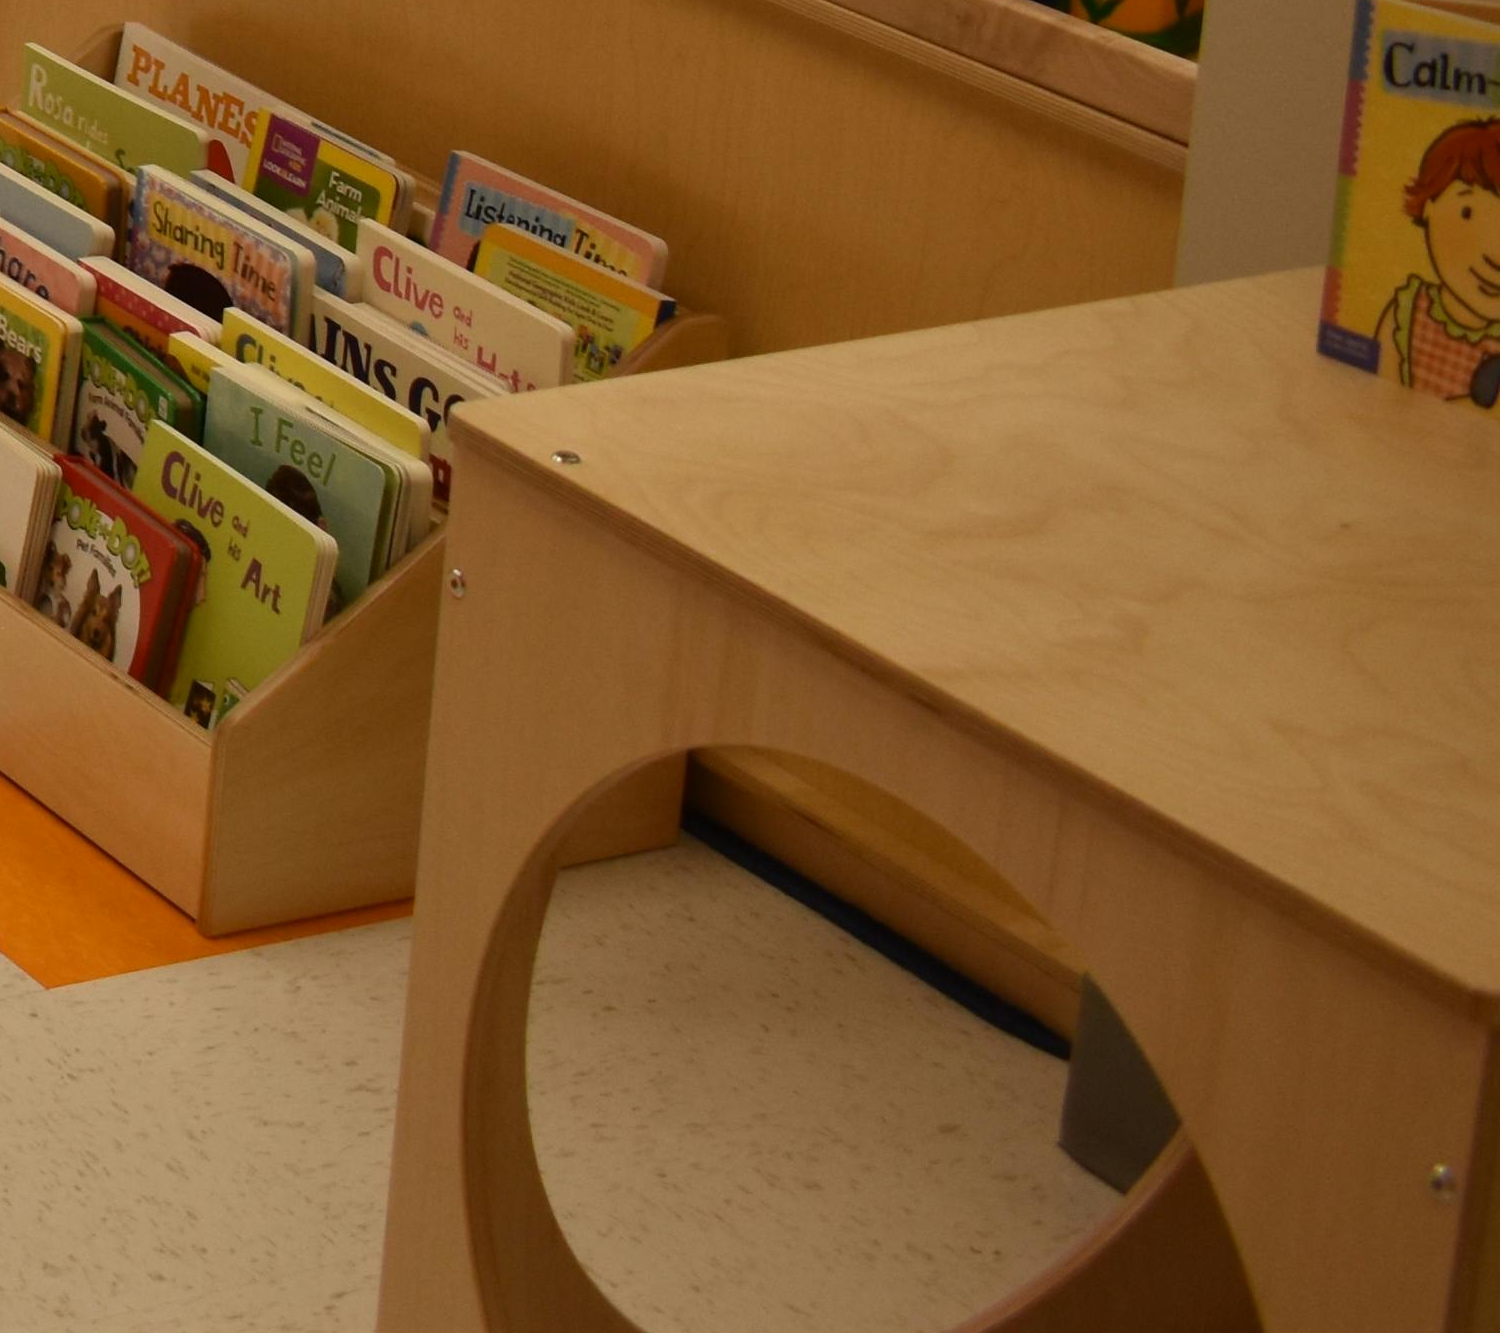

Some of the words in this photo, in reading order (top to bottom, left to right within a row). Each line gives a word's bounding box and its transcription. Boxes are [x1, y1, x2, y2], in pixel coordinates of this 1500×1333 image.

[28, 63, 75, 127] Rosa
[315, 189, 364, 223] Animal
[328, 170, 363, 203] Farm
[151, 200, 227, 270] Sharing
[232, 241, 278, 303] Time
[371, 244, 445, 320] Clive
[248, 406, 265, 448] I
[275, 422, 337, 488] Feel
[161, 449, 227, 526] Clive
[231, 514, 250, 538] and
[227, 536, 243, 562] his
[240, 557, 284, 616] Art
